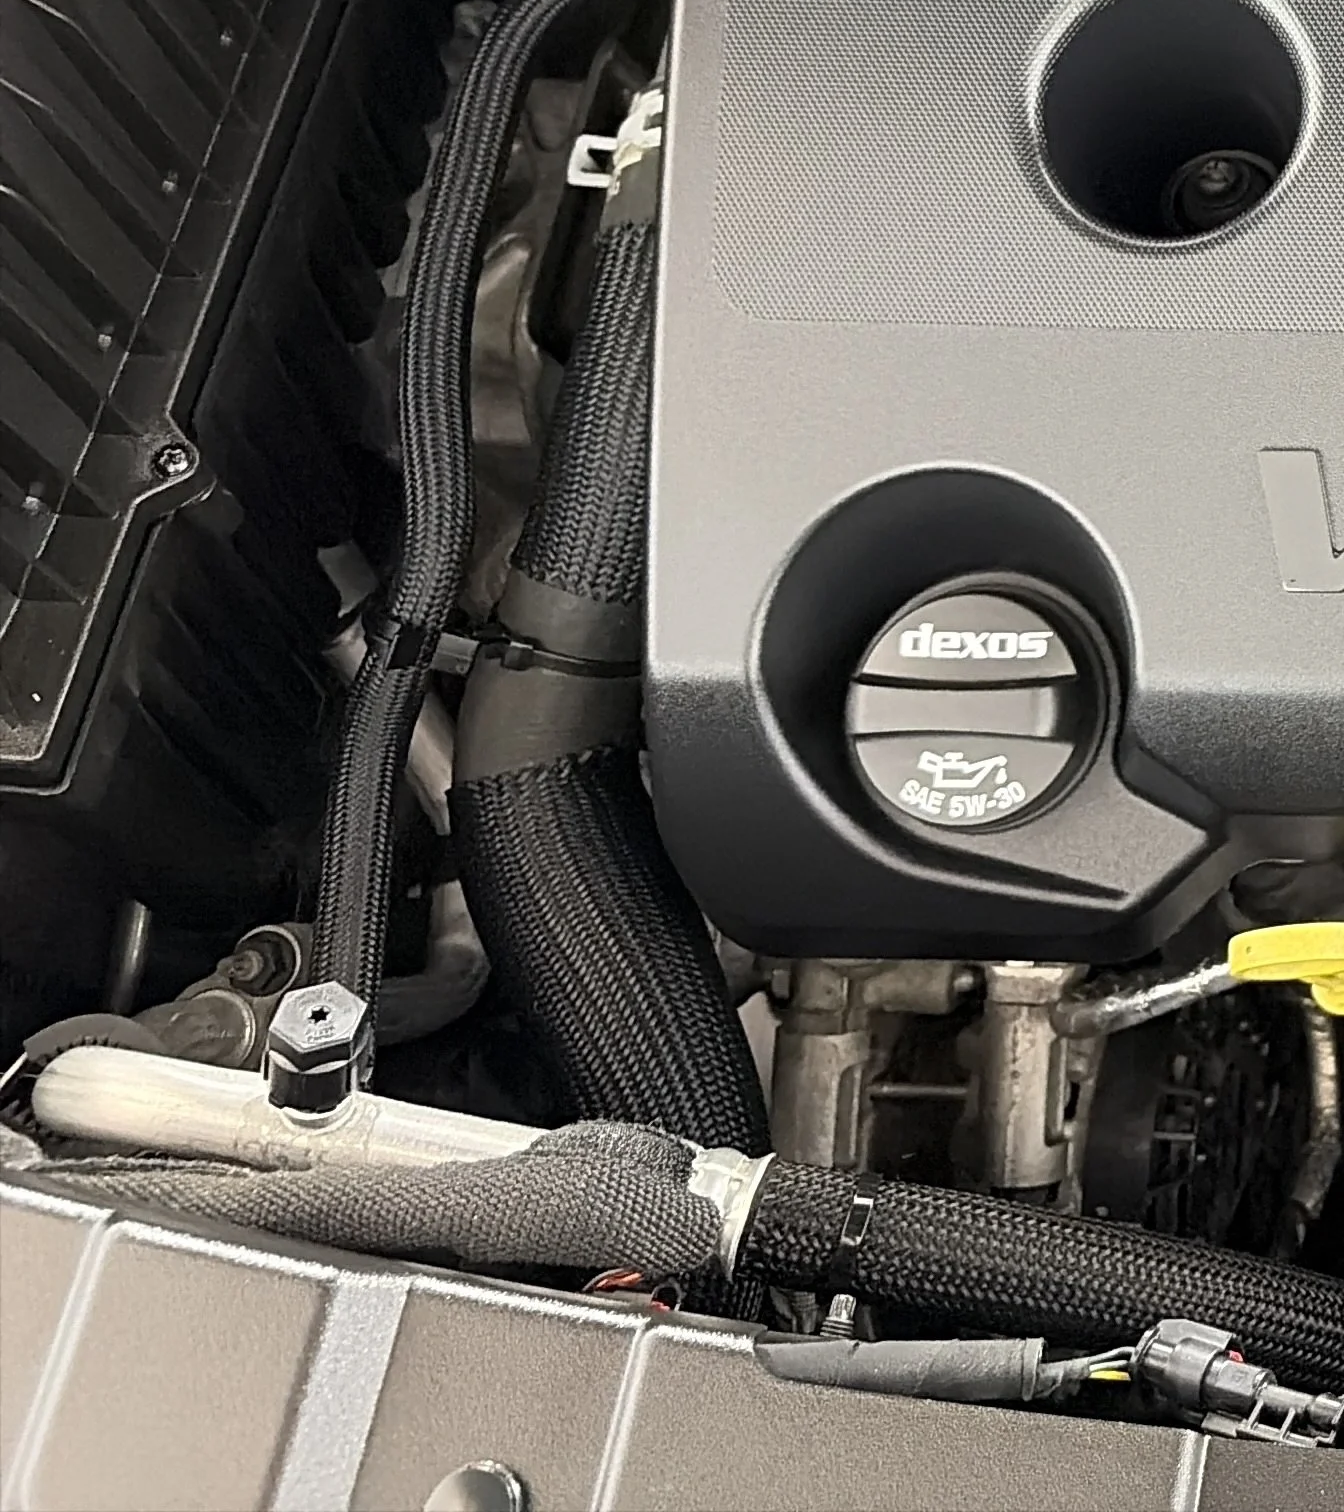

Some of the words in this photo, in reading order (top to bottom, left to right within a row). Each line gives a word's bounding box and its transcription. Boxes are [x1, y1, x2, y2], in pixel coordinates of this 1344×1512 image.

[899, 622, 1054, 660] dexos
[899, 778, 947, 816] SAE
[949, 780, 1027, 818] 5W-30
